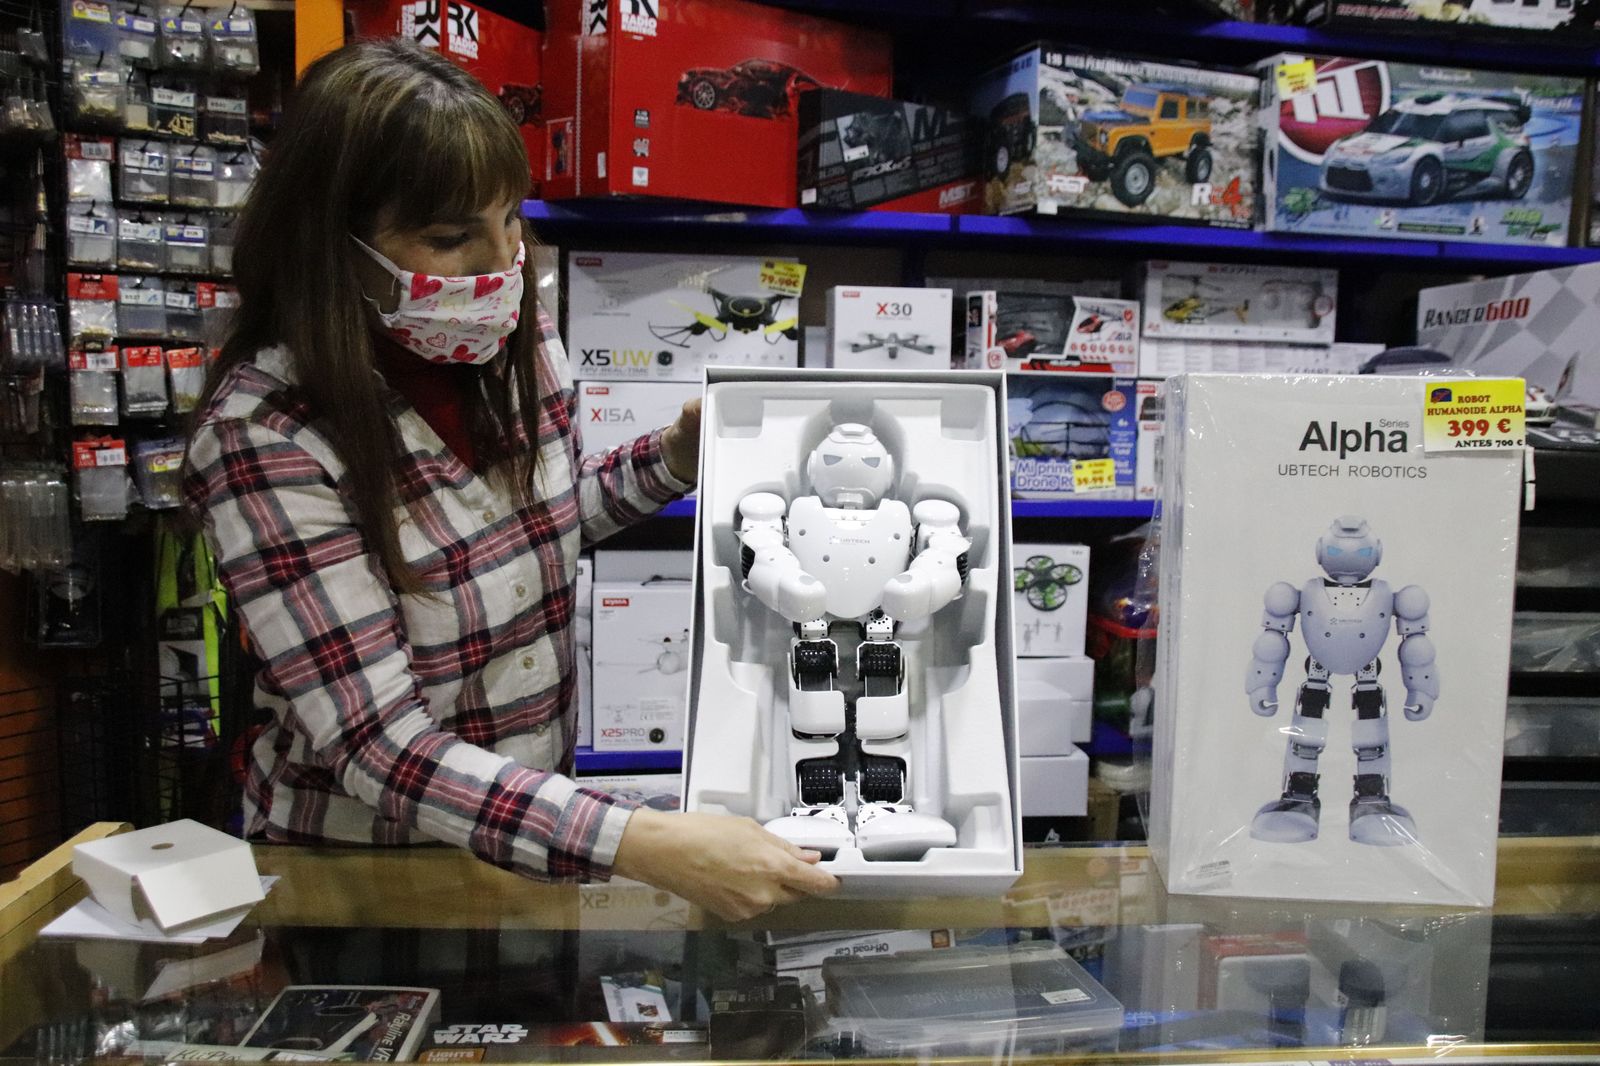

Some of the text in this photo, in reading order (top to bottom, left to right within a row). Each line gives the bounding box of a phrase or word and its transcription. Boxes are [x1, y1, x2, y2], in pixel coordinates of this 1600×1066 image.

[621, 13, 657, 28] RADIO
[876, 302, 912, 317] X30
[581, 349, 653, 367] X5UW
[1457, 395, 1491, 404] ROBOT
[1427, 405, 1523, 416] HUMANOIDE ALPHA
[1378, 418, 1410, 429] Series
[1447, 418, 1511, 437] 399 €
[1299, 420, 1408, 460] Alpha
[1455, 438, 1523, 448] ANTES 700 €
[1278, 463, 1428, 479] UBTECH ROBOTICS
[444, 1024, 524, 1034] STAR
[433, 1031, 529, 1044] WARS
